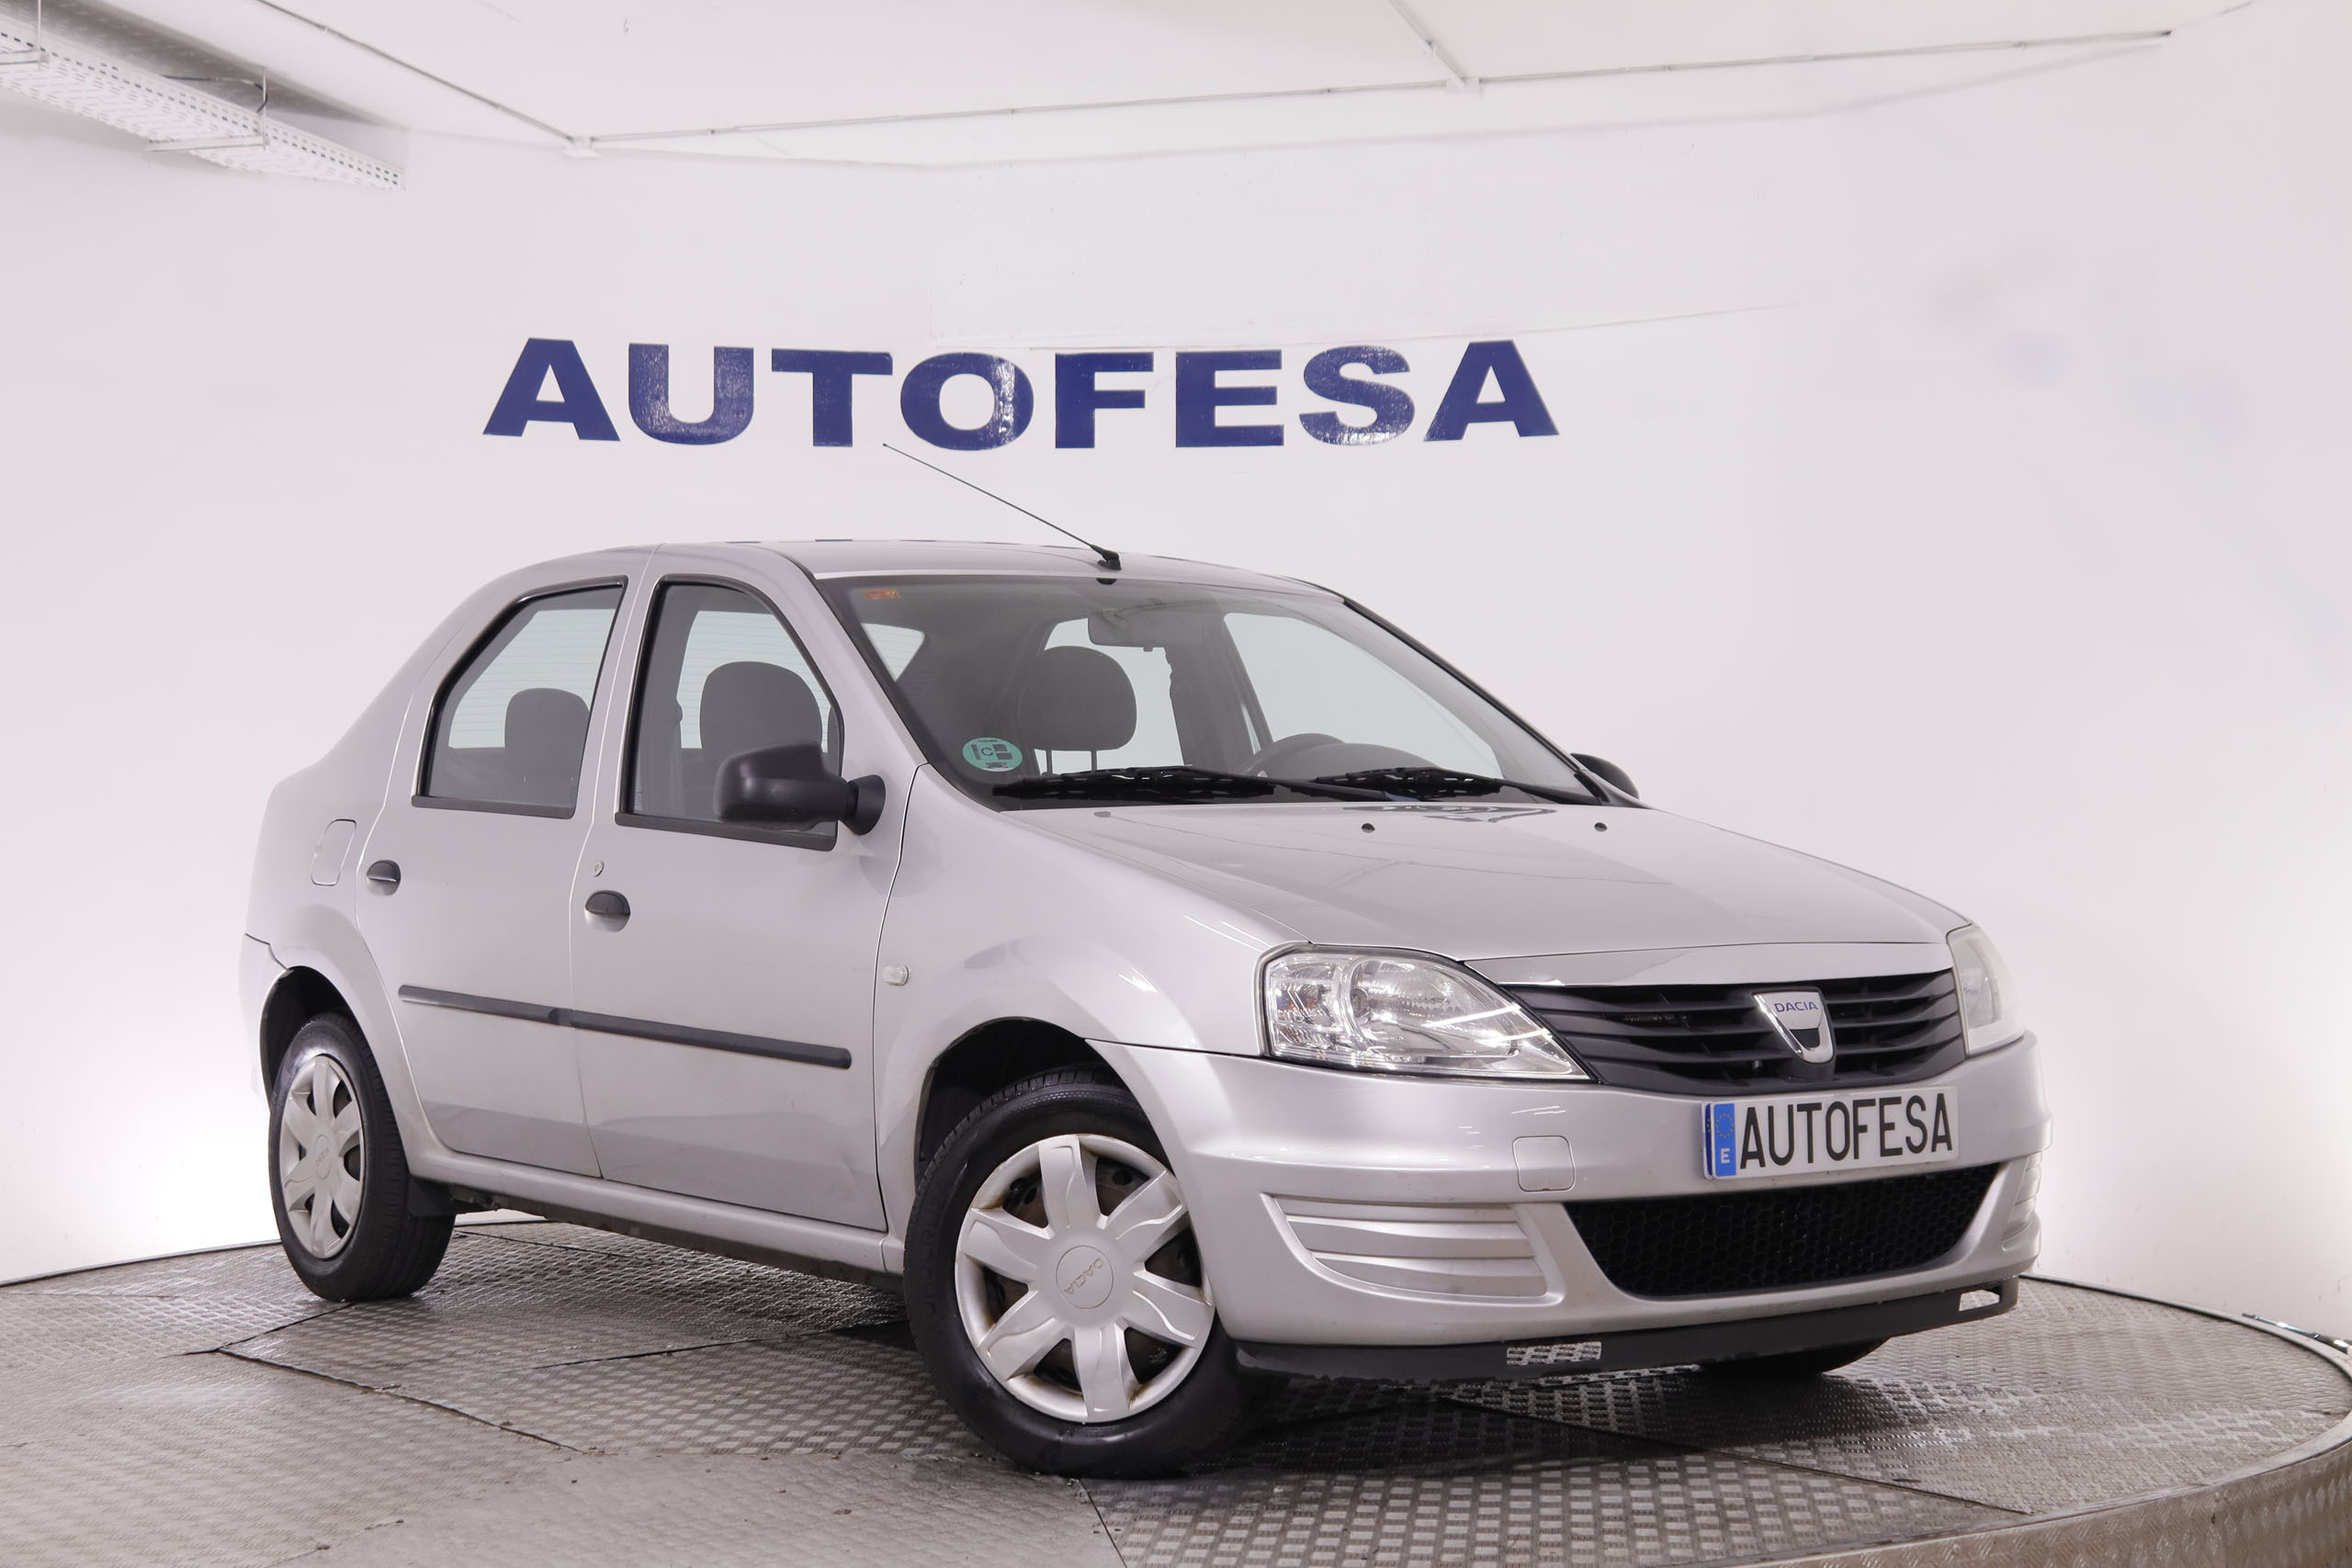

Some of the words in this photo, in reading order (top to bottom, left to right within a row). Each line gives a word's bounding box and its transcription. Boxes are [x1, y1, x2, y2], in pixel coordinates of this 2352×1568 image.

[482, 337, 1560, 449] AUTOFESA
[1774, 1000, 1819, 1013] DACIA
[1740, 1092, 1953, 1169] AUTOFESA
[1721, 1147, 1730, 1164] E
[1064, 1257, 1103, 1295] DACIA
